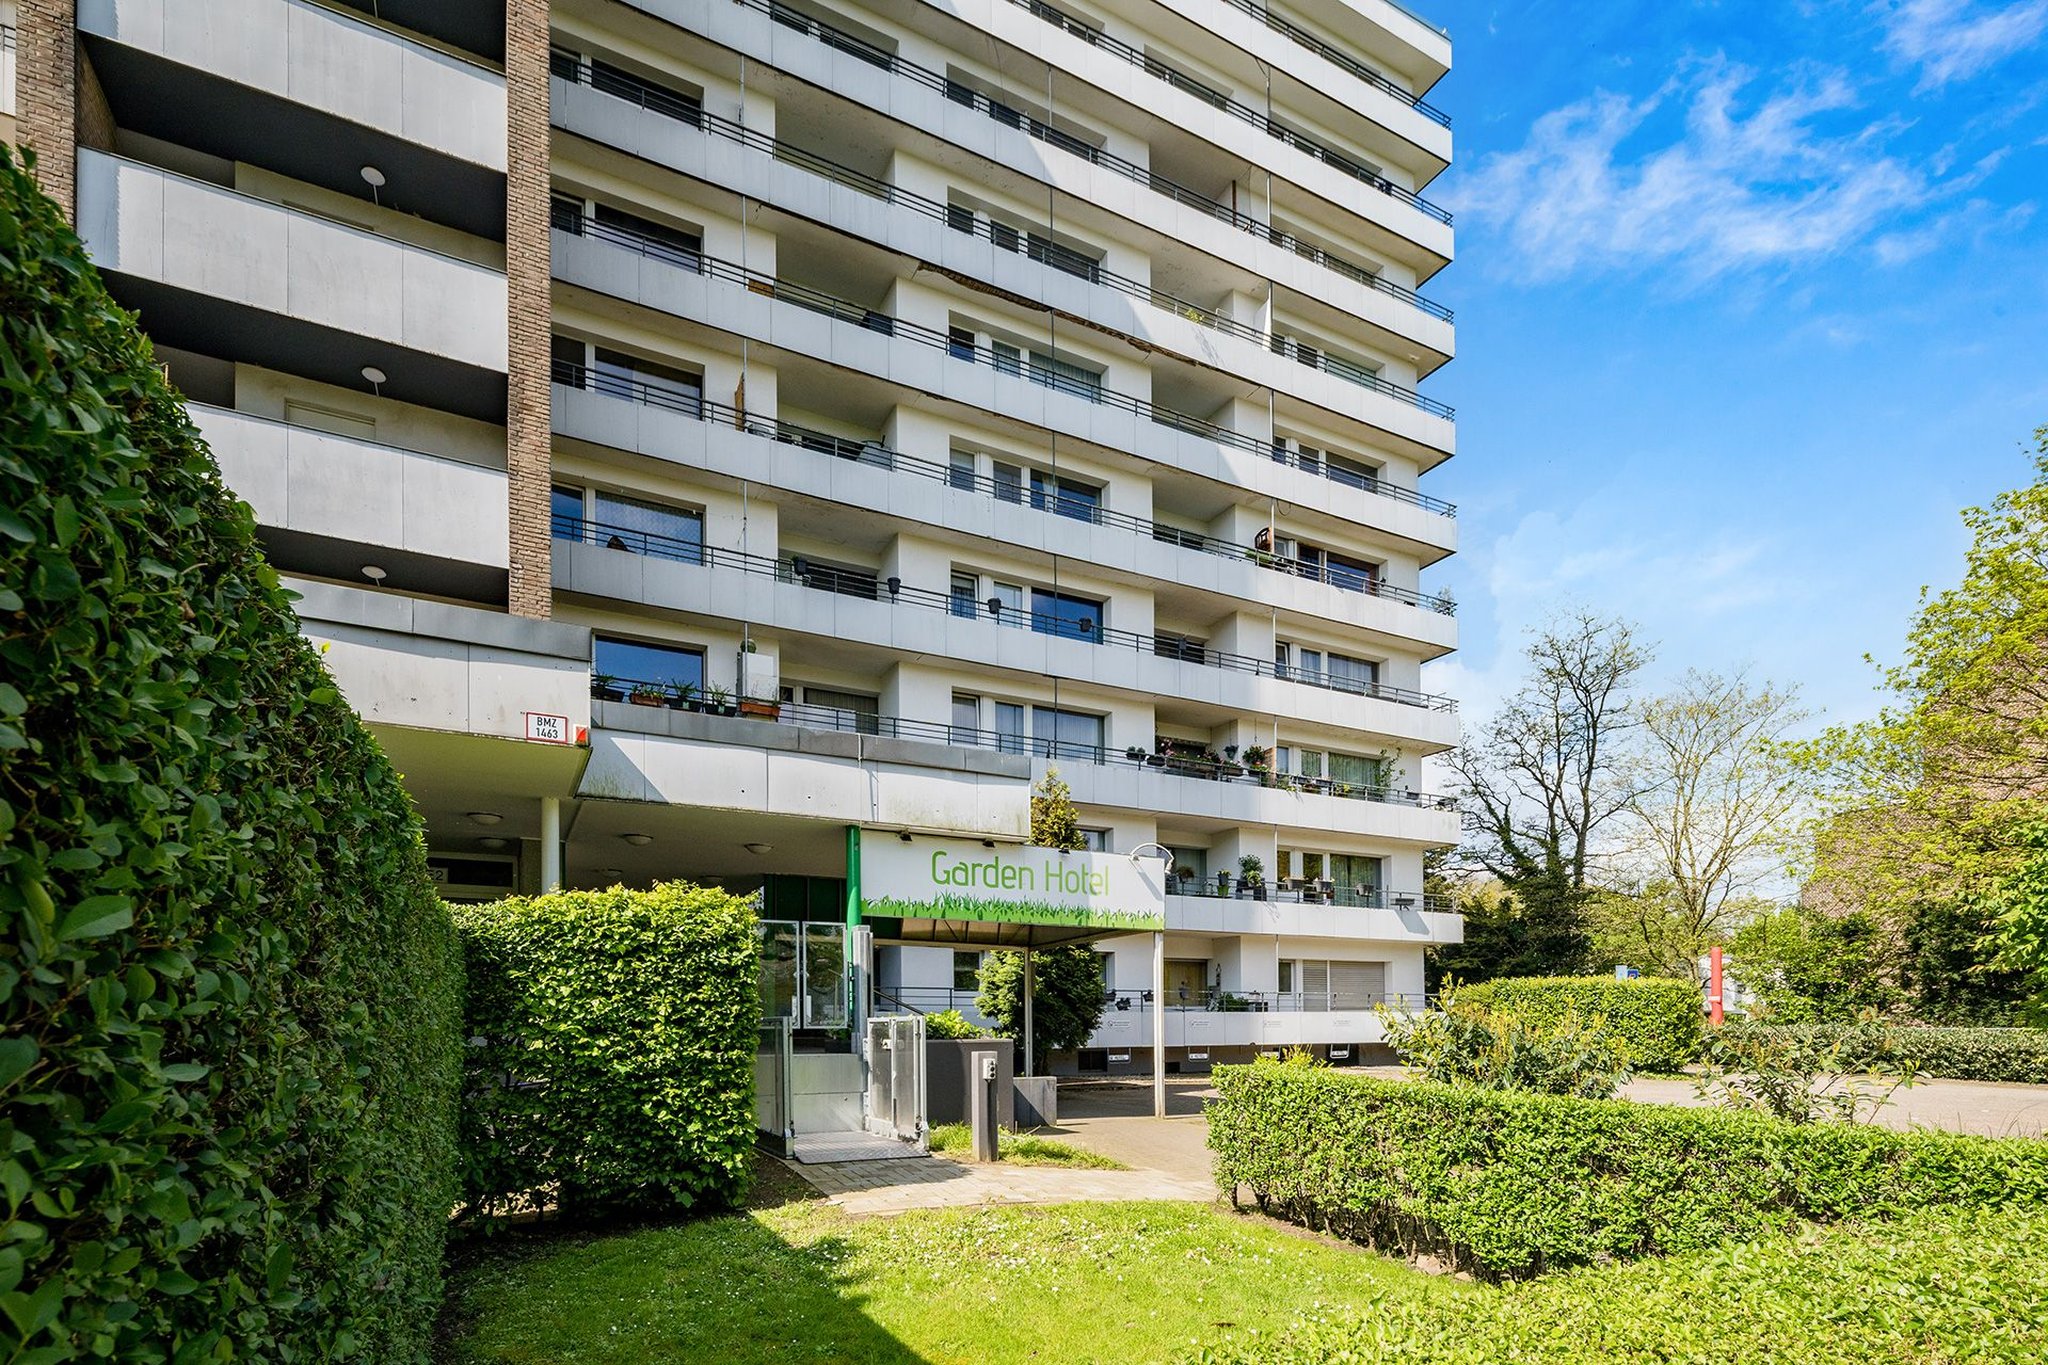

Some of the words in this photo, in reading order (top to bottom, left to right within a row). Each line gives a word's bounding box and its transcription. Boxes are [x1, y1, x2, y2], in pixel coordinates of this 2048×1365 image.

[536, 716, 557, 728] BMZ
[535, 727, 558, 739] 1463
[931, 850, 1035, 891] Garden
[1045, 860, 1109, 896] Hotel
